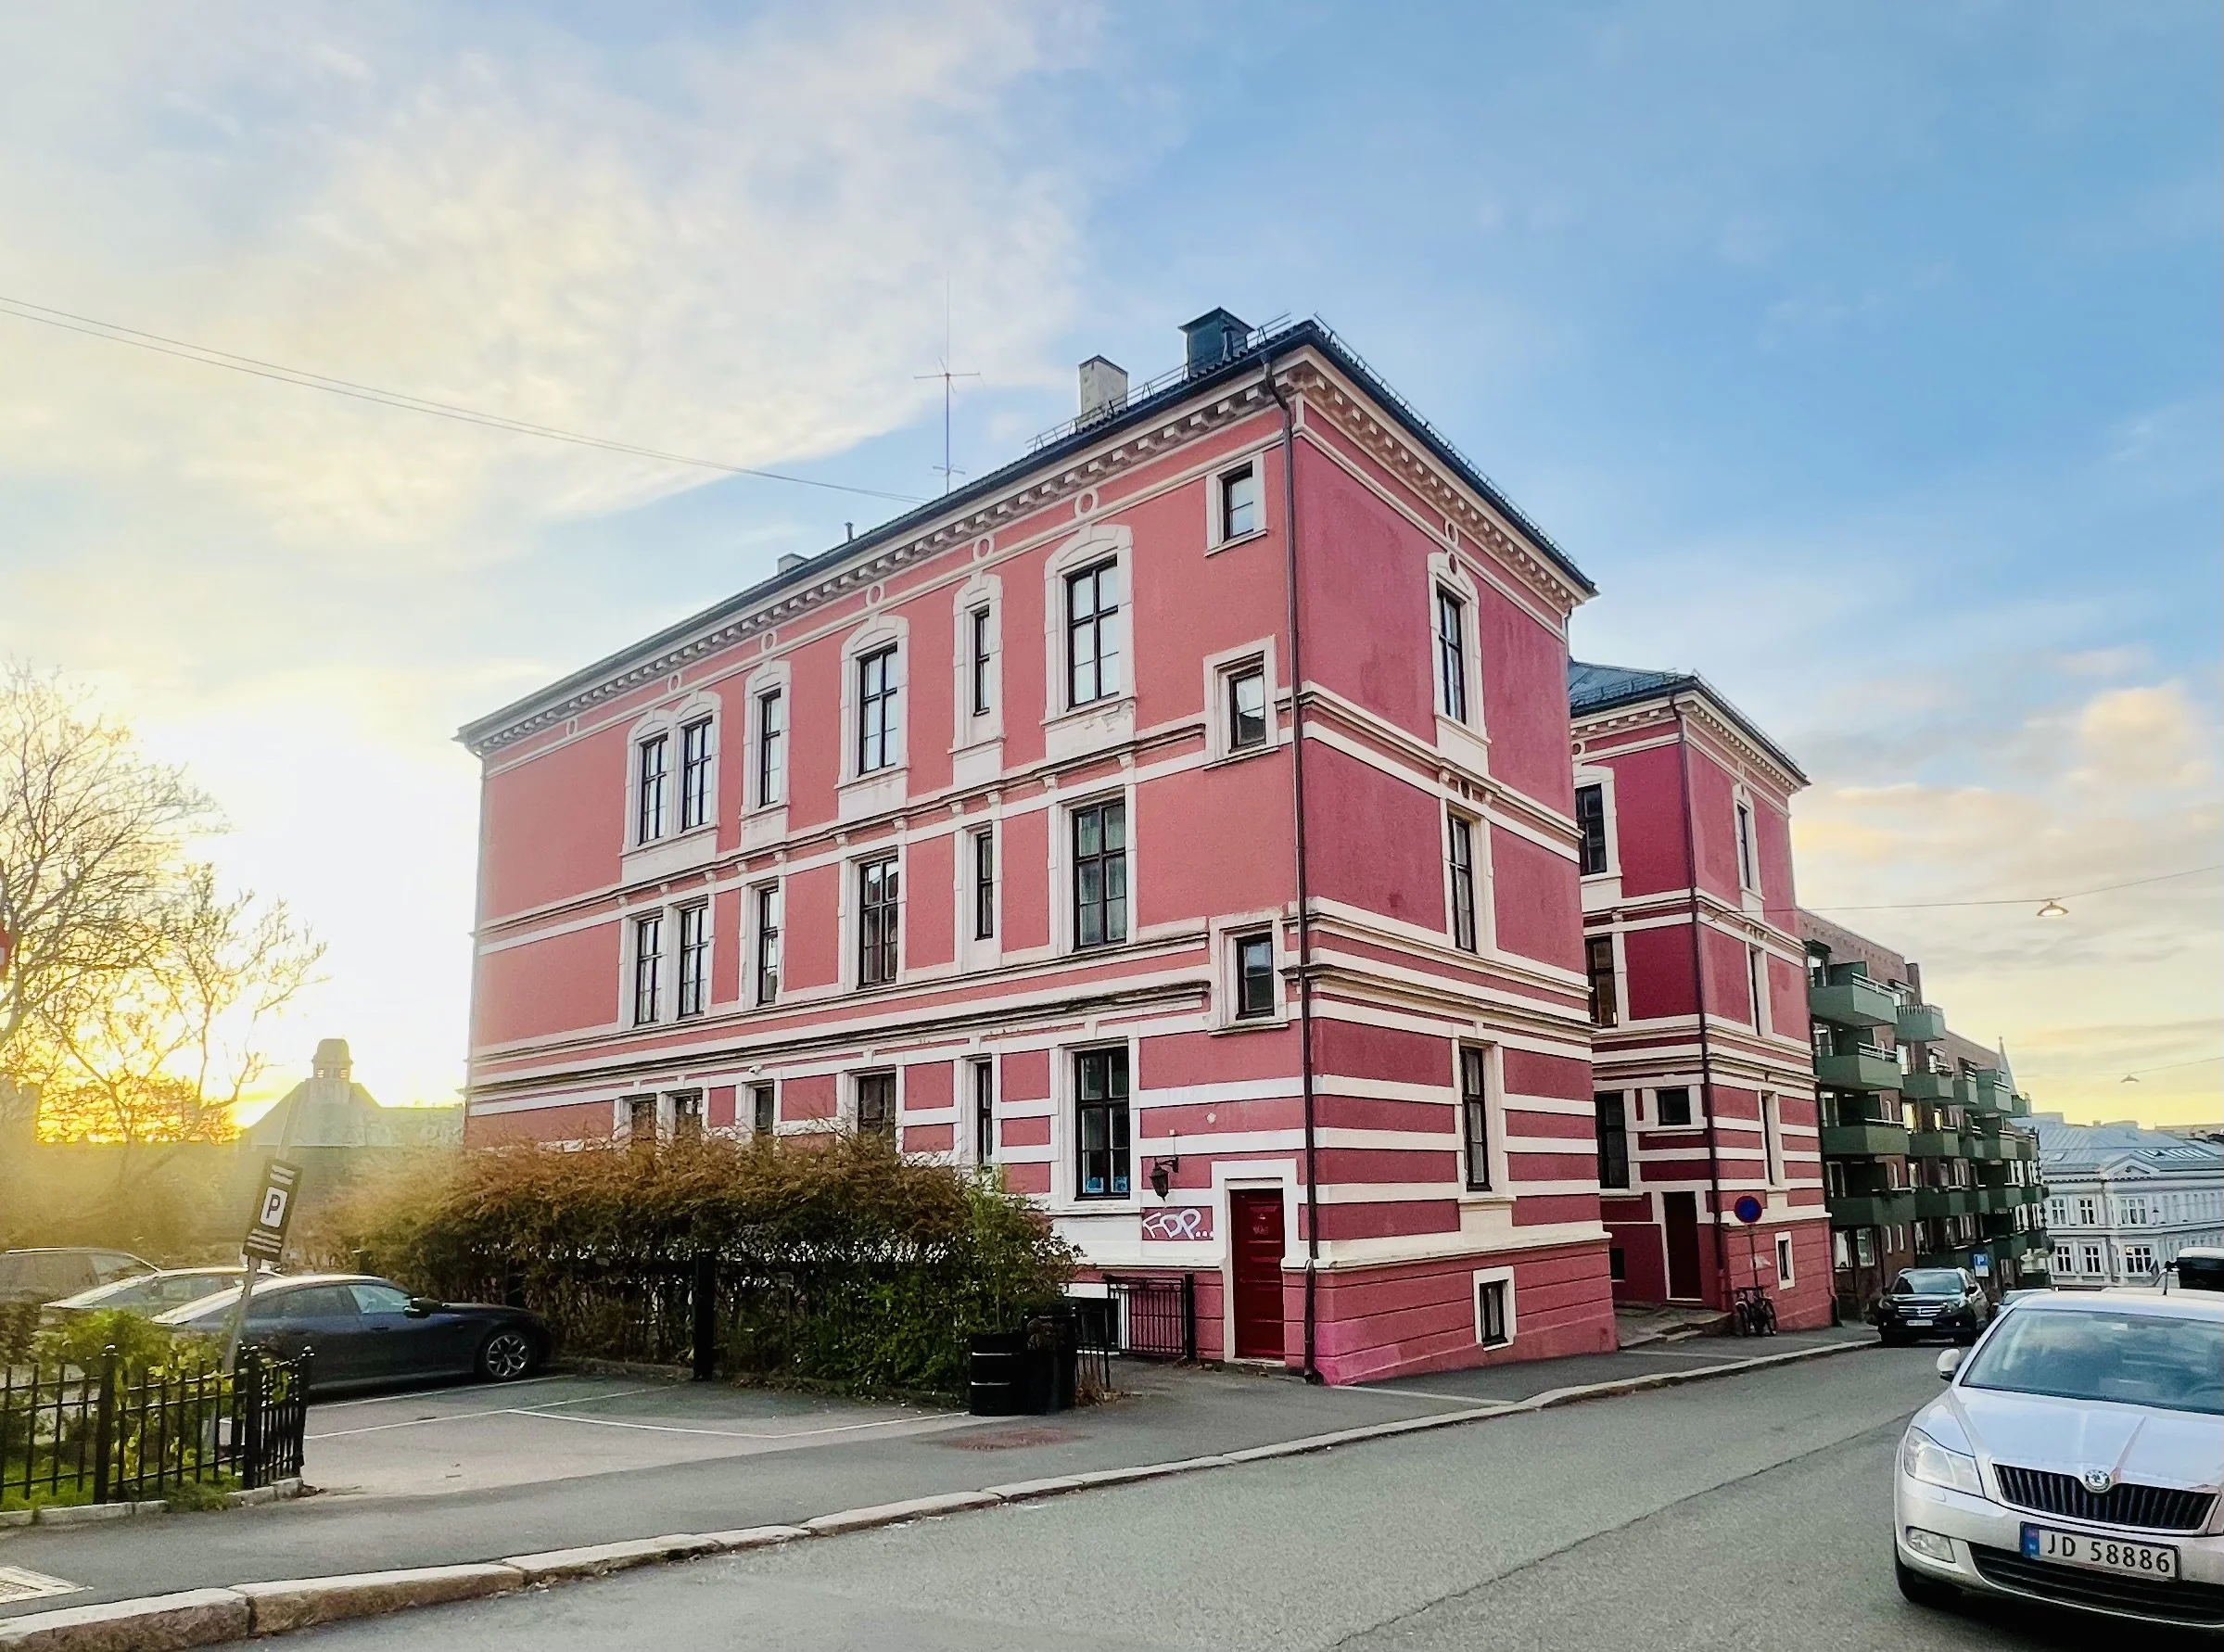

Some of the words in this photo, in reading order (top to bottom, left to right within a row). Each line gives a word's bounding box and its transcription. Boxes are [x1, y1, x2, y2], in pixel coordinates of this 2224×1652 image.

[265, 1194, 281, 1219] P
[1976, 1255, 1985, 1265] P
[2047, 1533, 2077, 1557] JD
[2090, 1541, 2170, 1573] 58886
